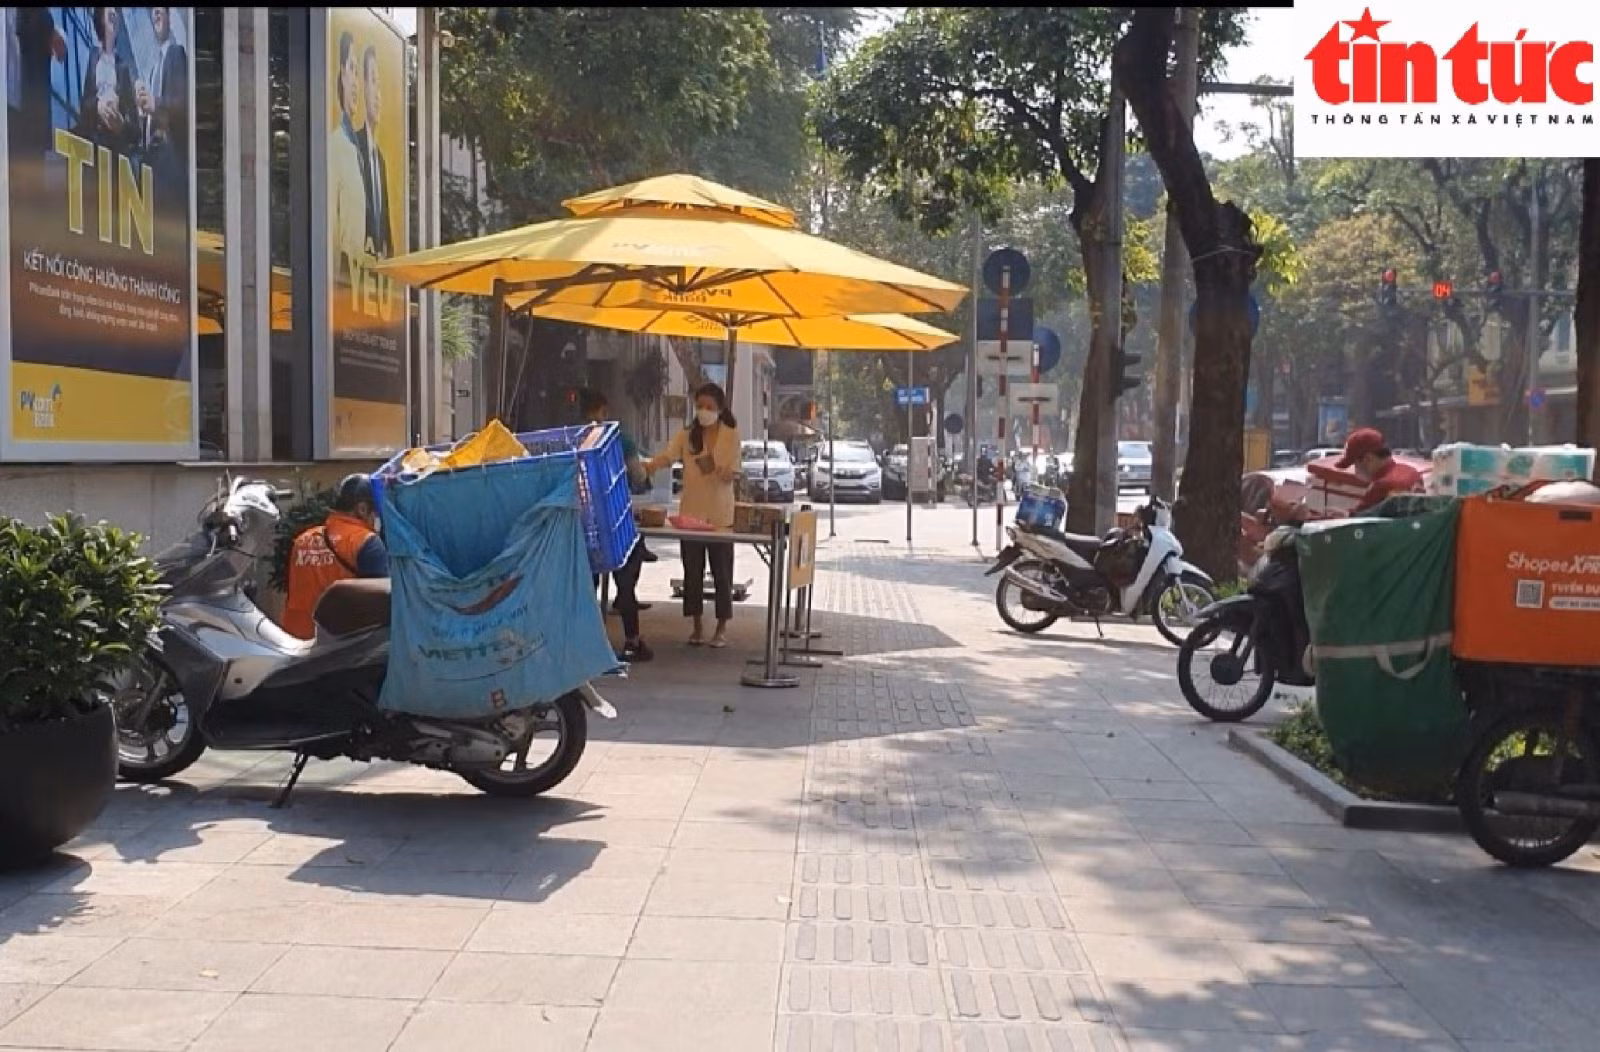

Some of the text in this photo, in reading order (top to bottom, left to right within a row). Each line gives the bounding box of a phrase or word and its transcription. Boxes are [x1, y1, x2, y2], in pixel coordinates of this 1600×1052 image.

[54, 127, 154, 256] TIN
[23, 247, 45, 272] KẾT
[46, 253, 65, 278] NỐI
